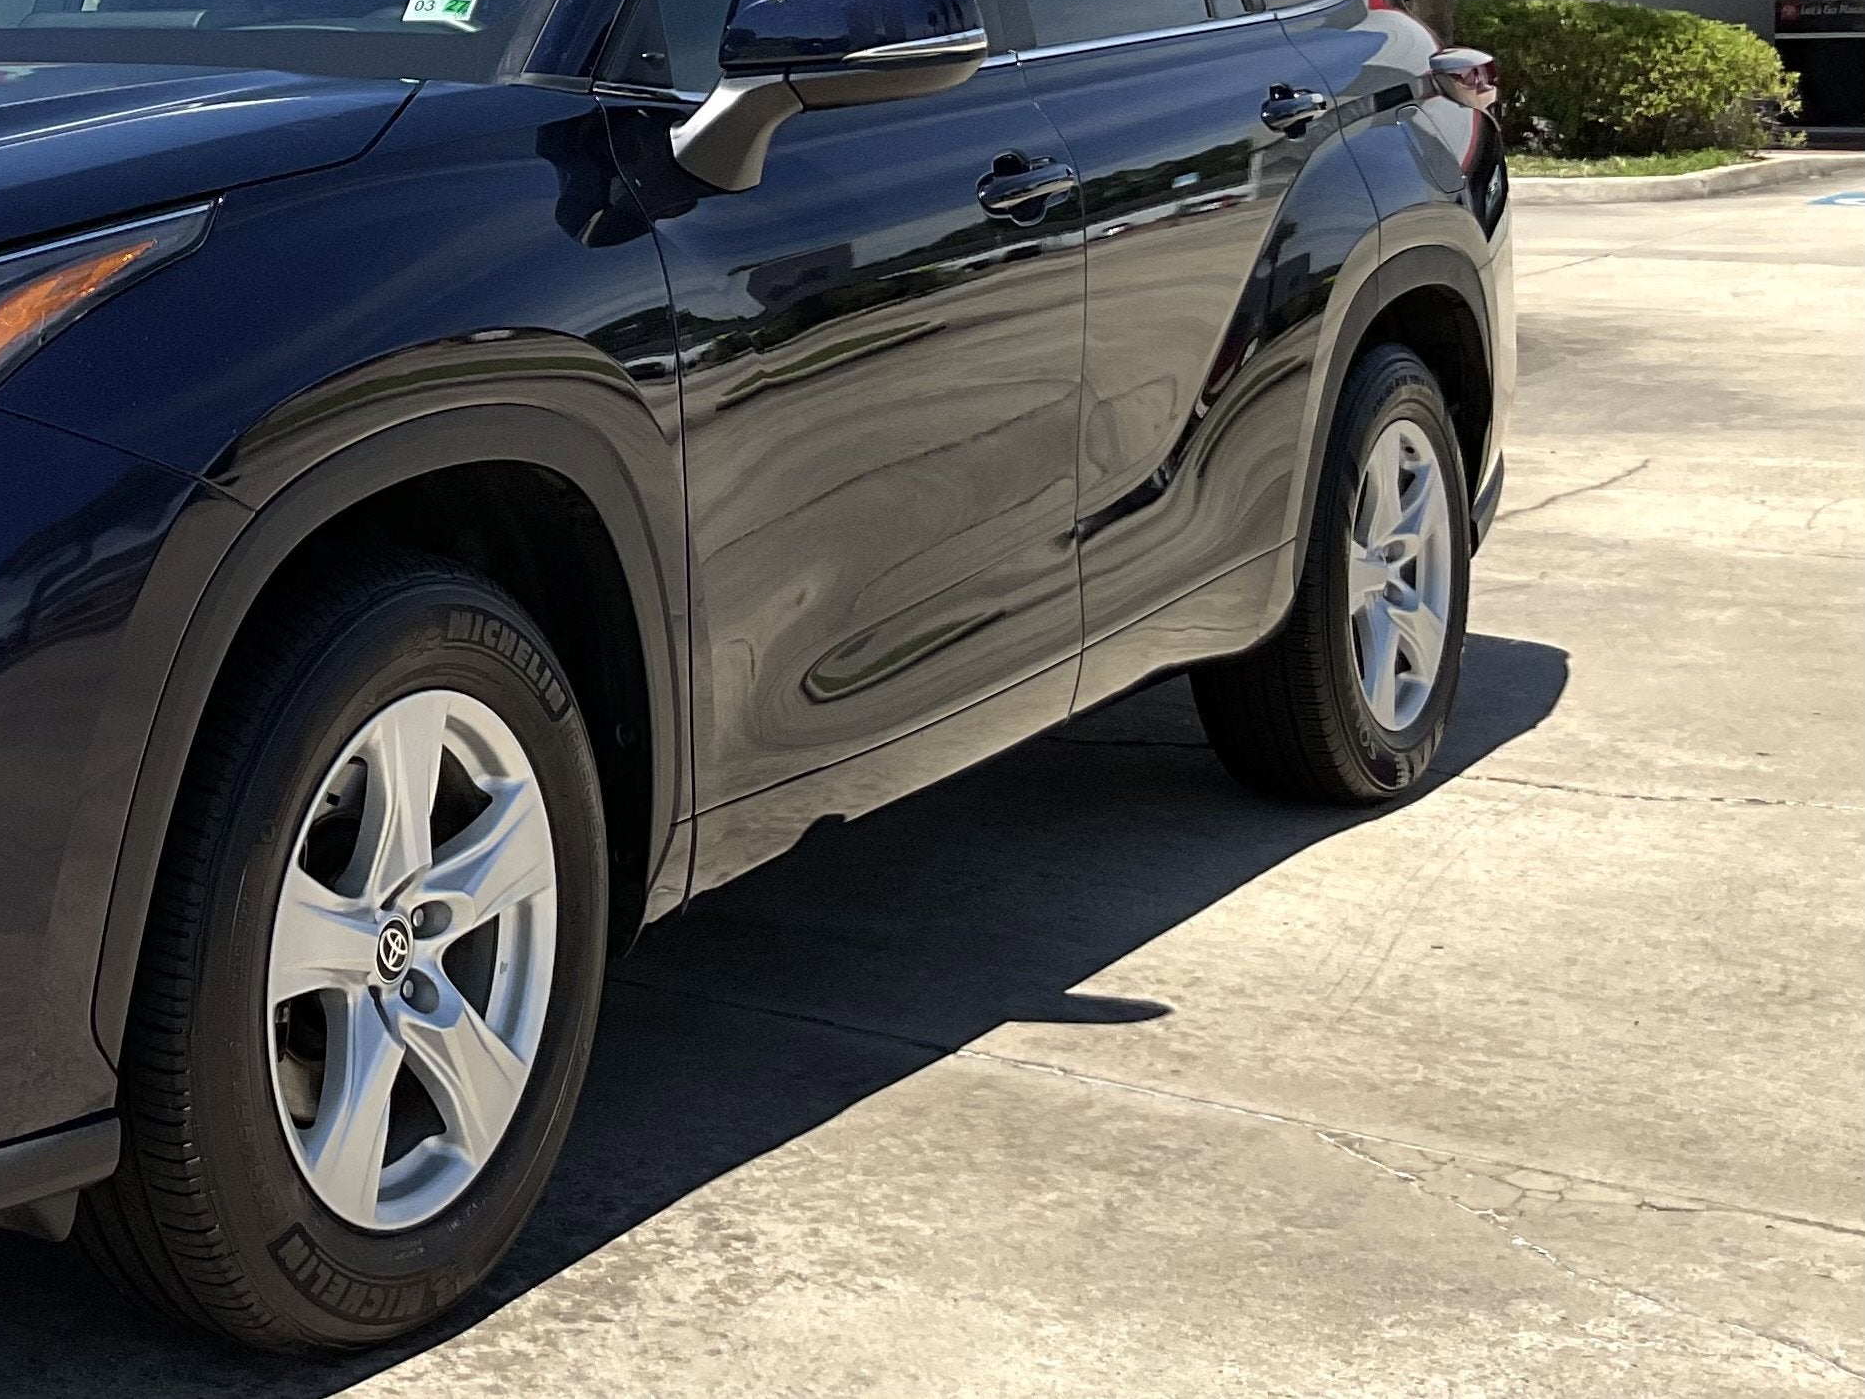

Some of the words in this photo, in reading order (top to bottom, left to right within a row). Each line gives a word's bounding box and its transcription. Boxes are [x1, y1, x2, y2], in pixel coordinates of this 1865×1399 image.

[414, 0, 436, 12] 03
[447, 610, 566, 714] MICHELIN
[276, 1233, 426, 1319] MICHELIN
